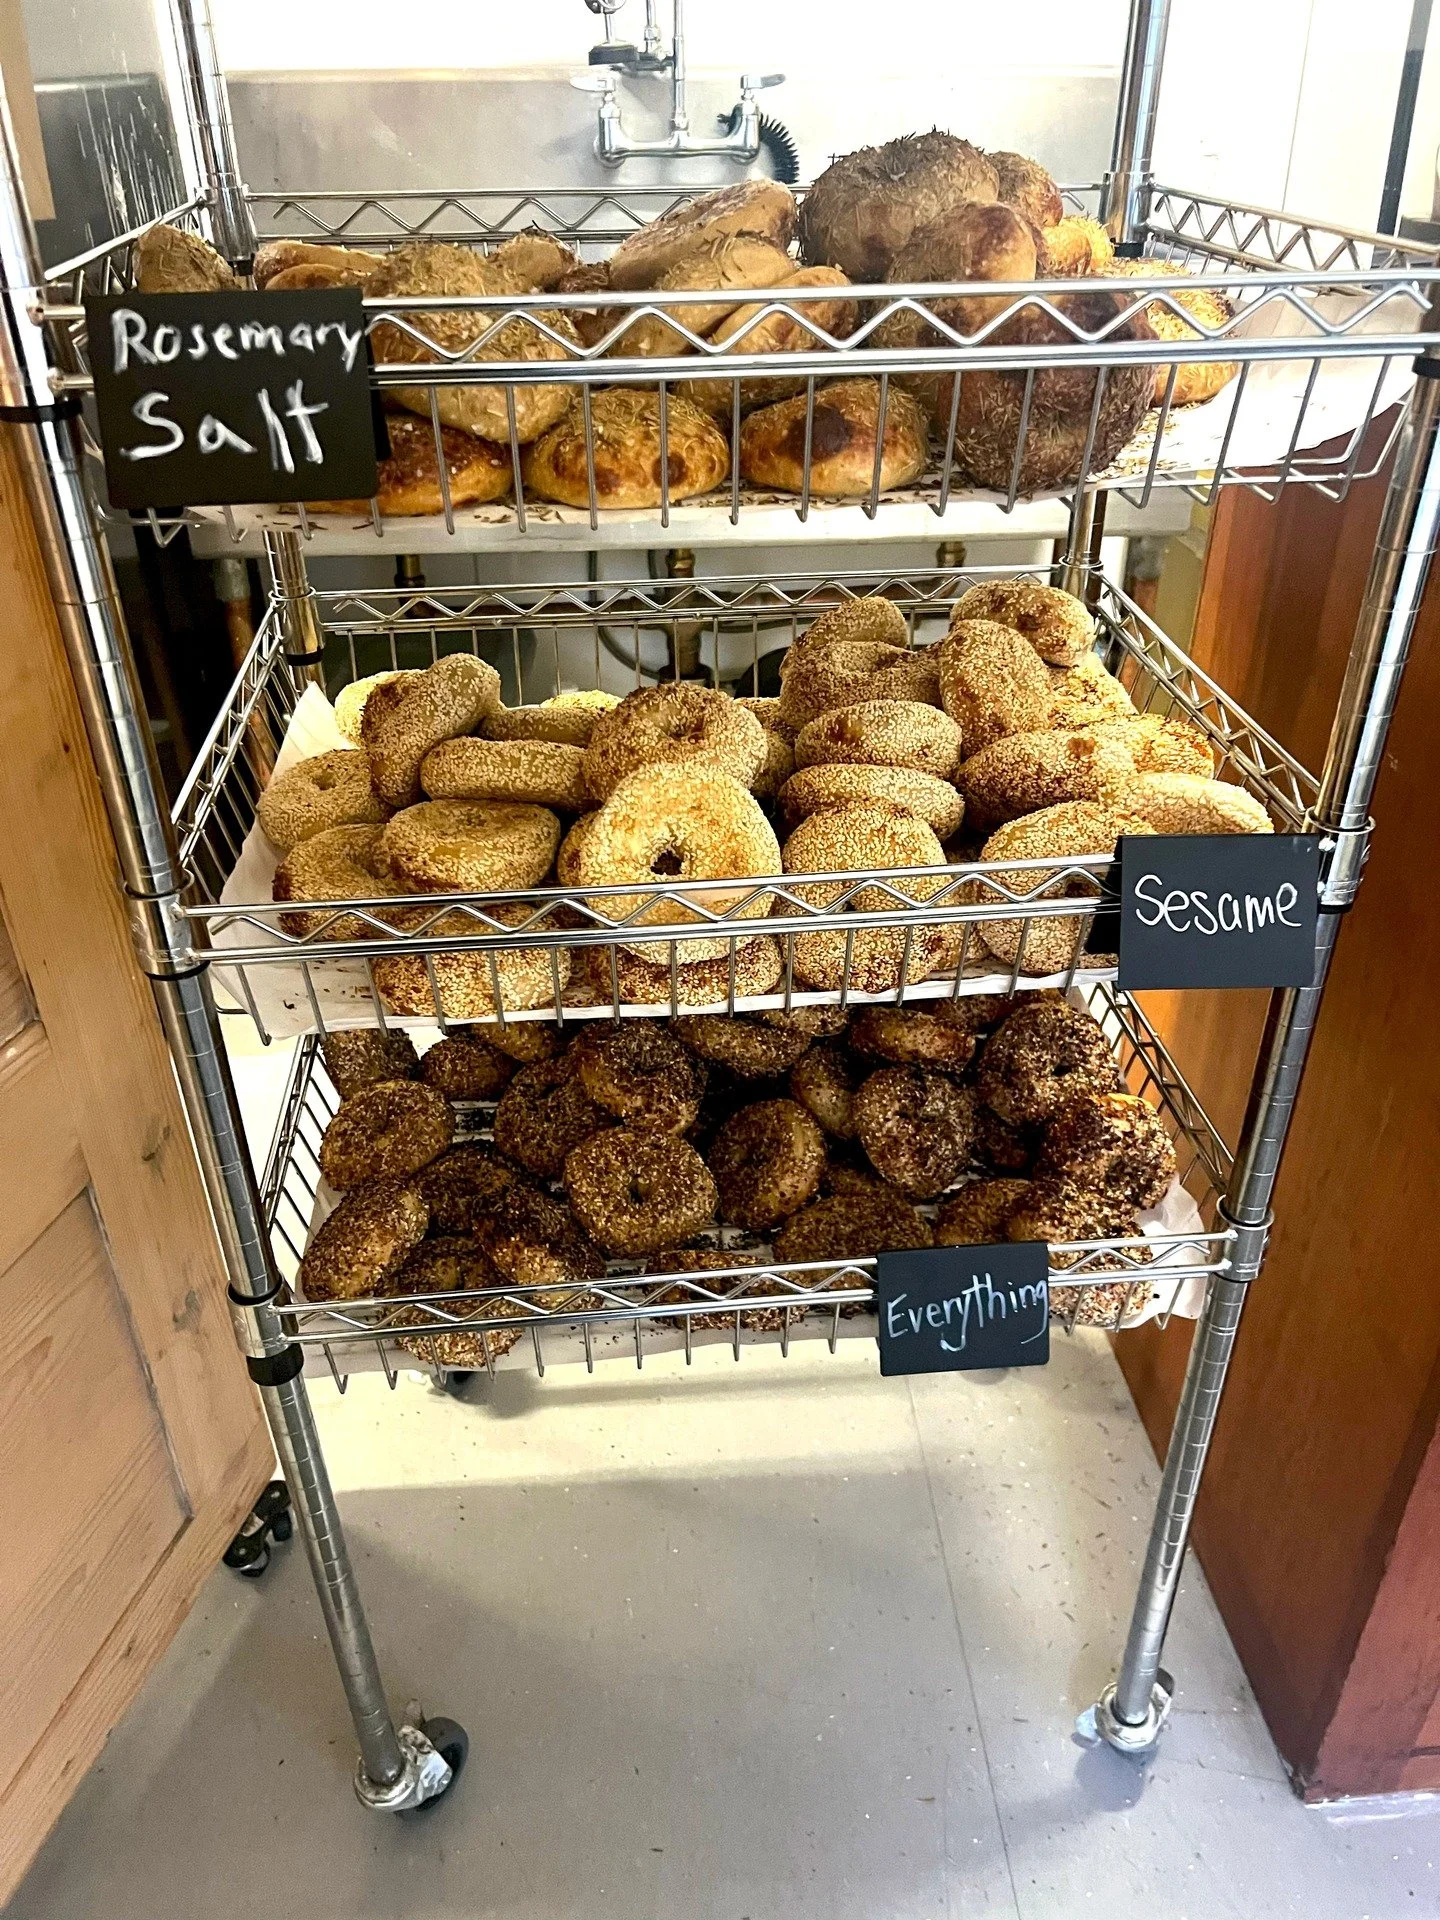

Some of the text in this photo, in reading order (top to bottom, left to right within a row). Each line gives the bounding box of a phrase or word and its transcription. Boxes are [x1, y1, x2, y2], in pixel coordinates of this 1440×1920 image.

[112, 309, 364, 373] Rosemary
[120, 380, 328, 473] Salt
[1134, 874, 1301, 935] Sesame
[887, 1273, 1049, 1352] Everything
